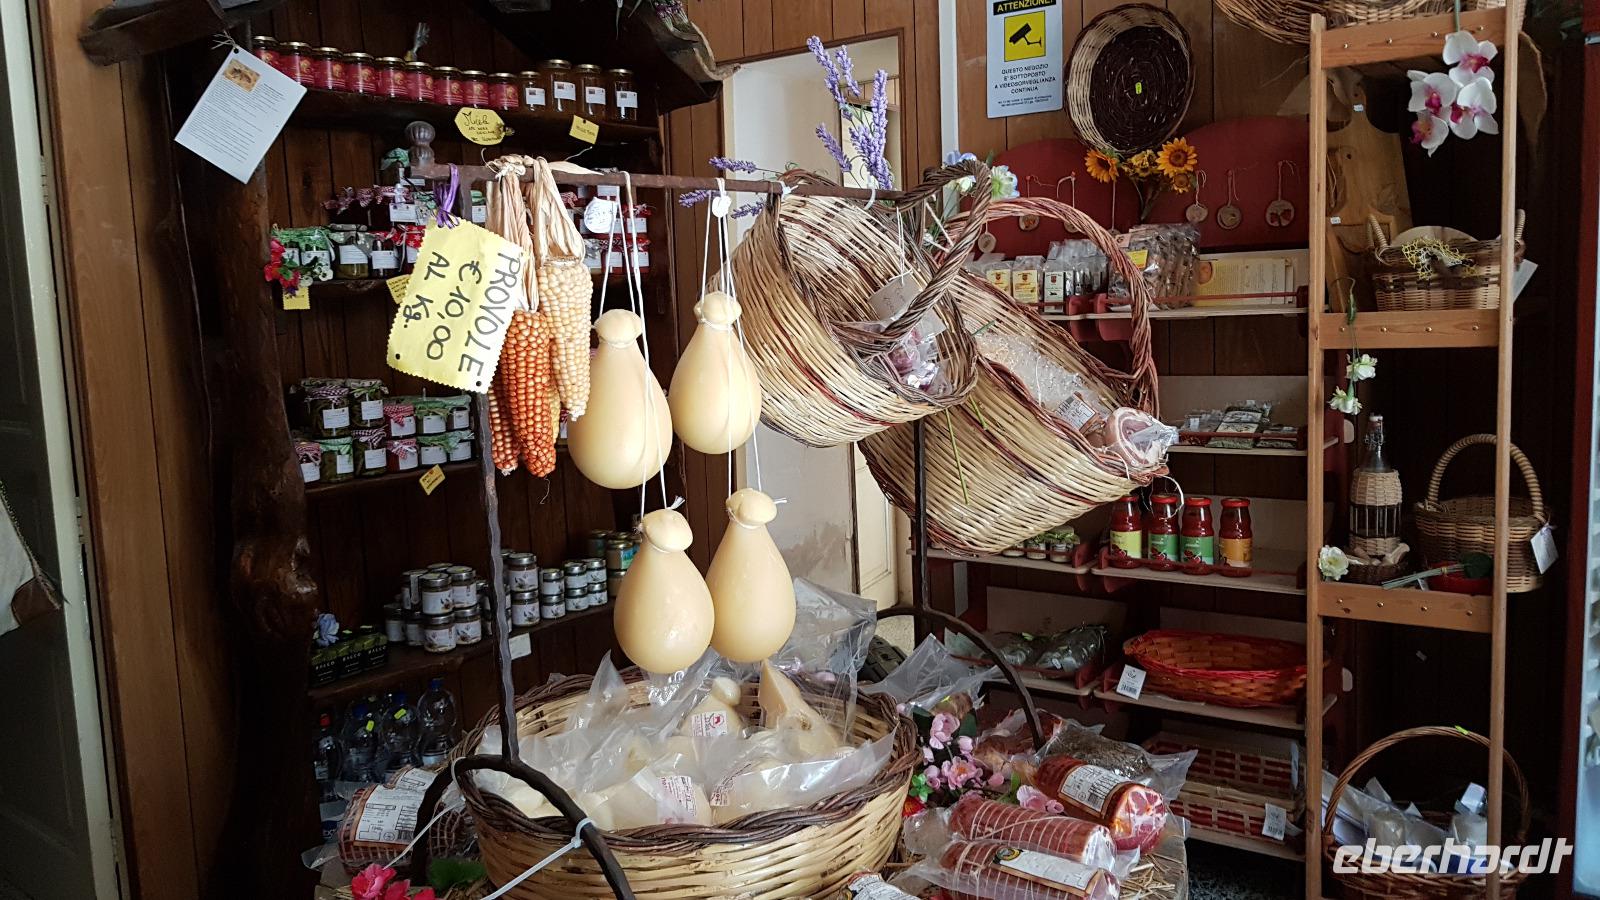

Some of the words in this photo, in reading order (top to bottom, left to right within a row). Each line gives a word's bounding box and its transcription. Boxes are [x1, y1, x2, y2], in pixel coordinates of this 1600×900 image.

[1001, 66, 1023, 75] QUESTO
[1024, 63, 1049, 71] NEGOZIO
[1010, 70, 1046, 80] SOTTOPOSTO
[999, 76, 1056, 88] VIDEOSORVEGLIANZA
[1010, 86, 1039, 94] CONTINUA
[424, 251, 450, 281] AL
[458, 252, 521, 376] PROVOLE
